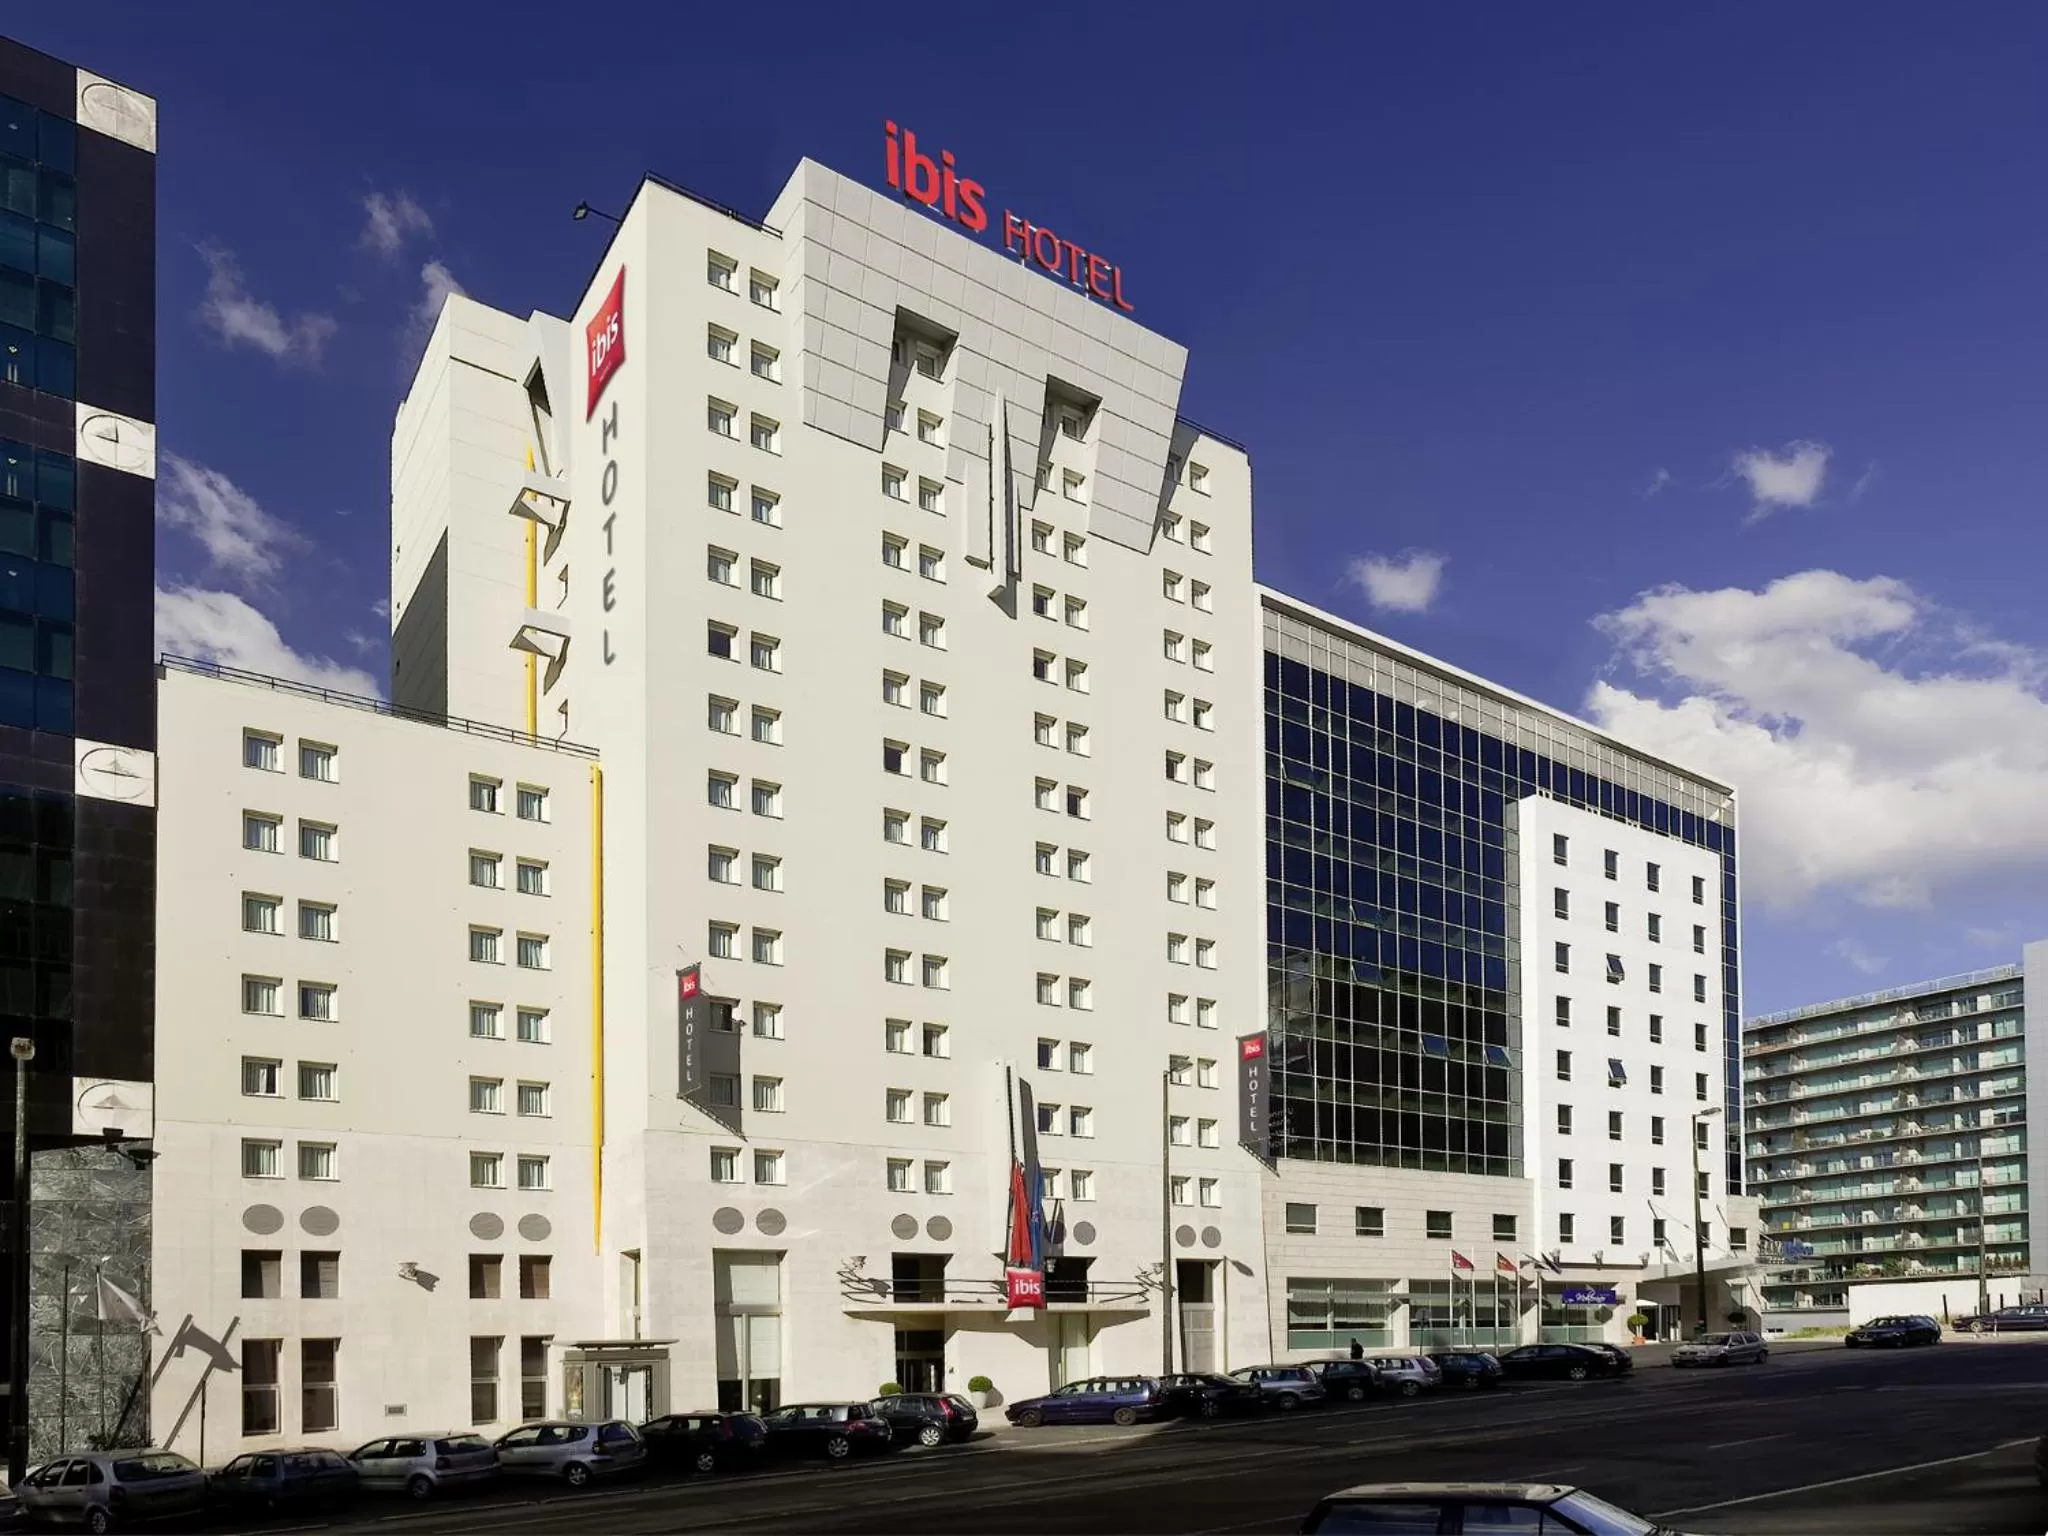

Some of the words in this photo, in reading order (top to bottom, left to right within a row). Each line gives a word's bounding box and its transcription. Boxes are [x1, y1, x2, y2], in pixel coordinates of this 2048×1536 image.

[885, 120, 987, 232] ibis
[1003, 209, 1134, 310] HOTEL
[592, 311, 618, 376] ibis
[602, 401, 617, 666] HOTEL
[685, 1007, 693, 1082] HOTEL
[1244, 1042, 1261, 1055] ibis
[1248, 1066, 1258, 1132] HOTEL
[1015, 1279, 1040, 1295] ibis
